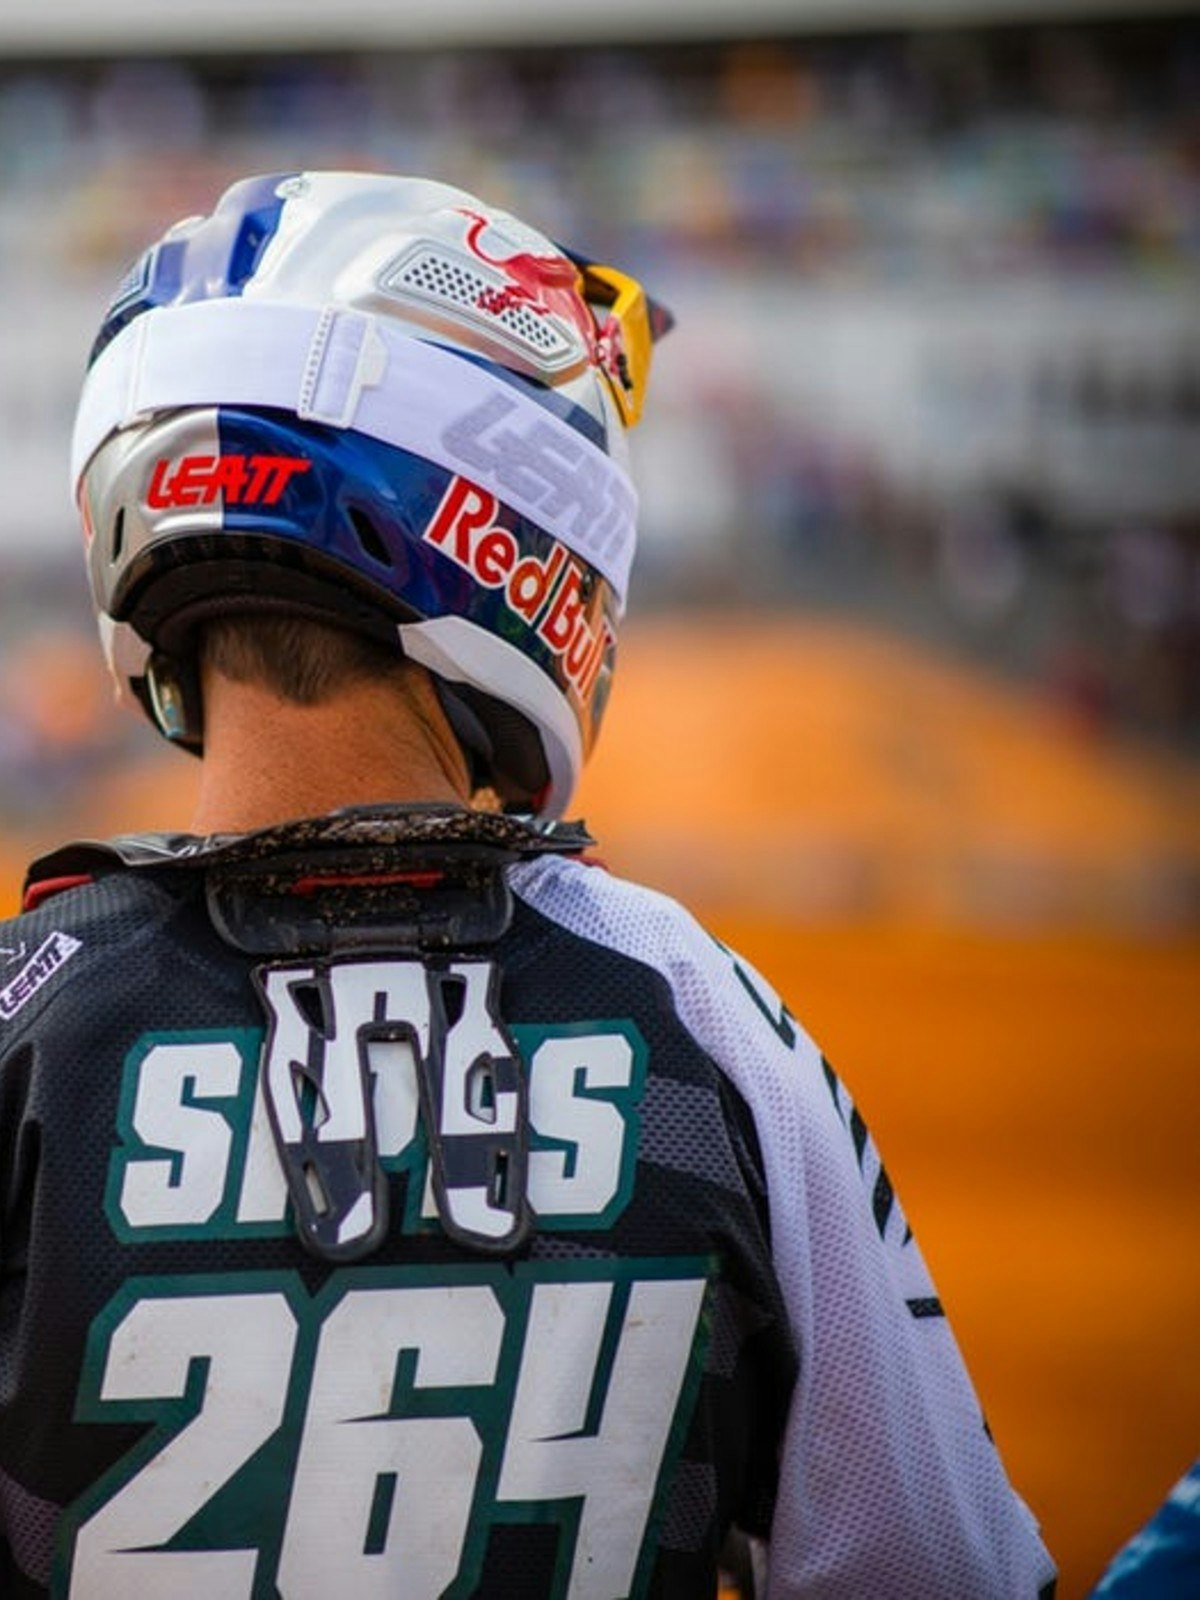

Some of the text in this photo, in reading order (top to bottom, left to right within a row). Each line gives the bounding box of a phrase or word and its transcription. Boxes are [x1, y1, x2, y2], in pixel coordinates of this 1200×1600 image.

[146, 455, 312, 509] LEATT
[441, 391, 636, 561] LEATT
[67, 1277, 707, 1600] 264
